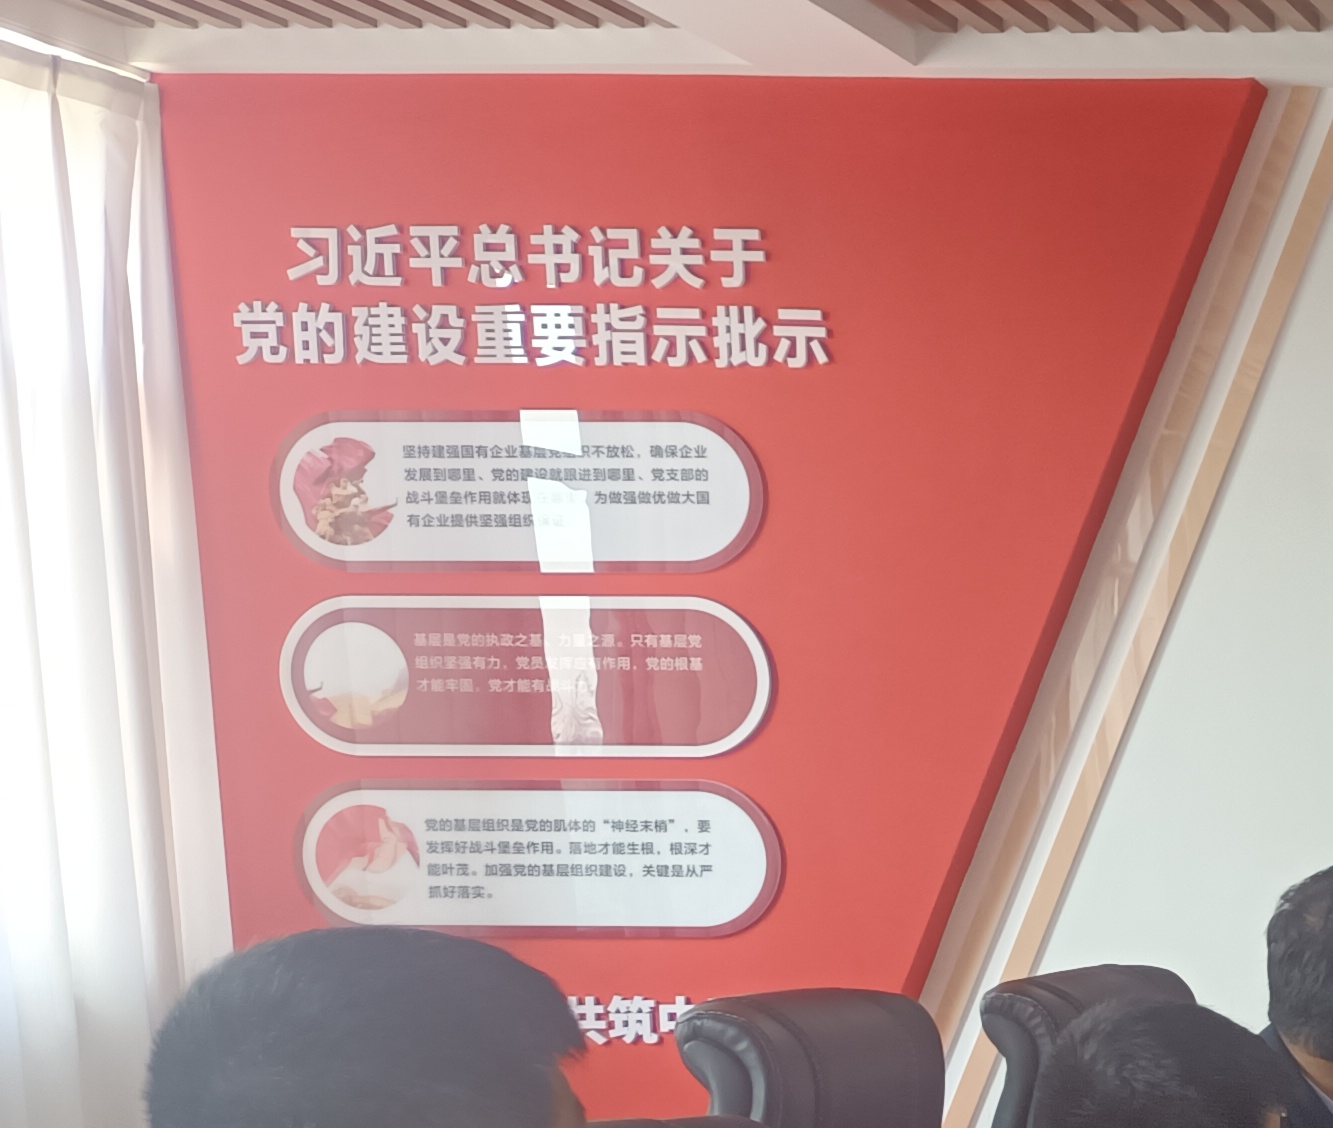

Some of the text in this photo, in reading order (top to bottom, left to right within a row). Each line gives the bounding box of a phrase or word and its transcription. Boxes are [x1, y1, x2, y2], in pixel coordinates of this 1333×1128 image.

[286, 224, 766, 289] 习近平总书记关于
[233, 300, 830, 369] 党的建设重要指示批示
